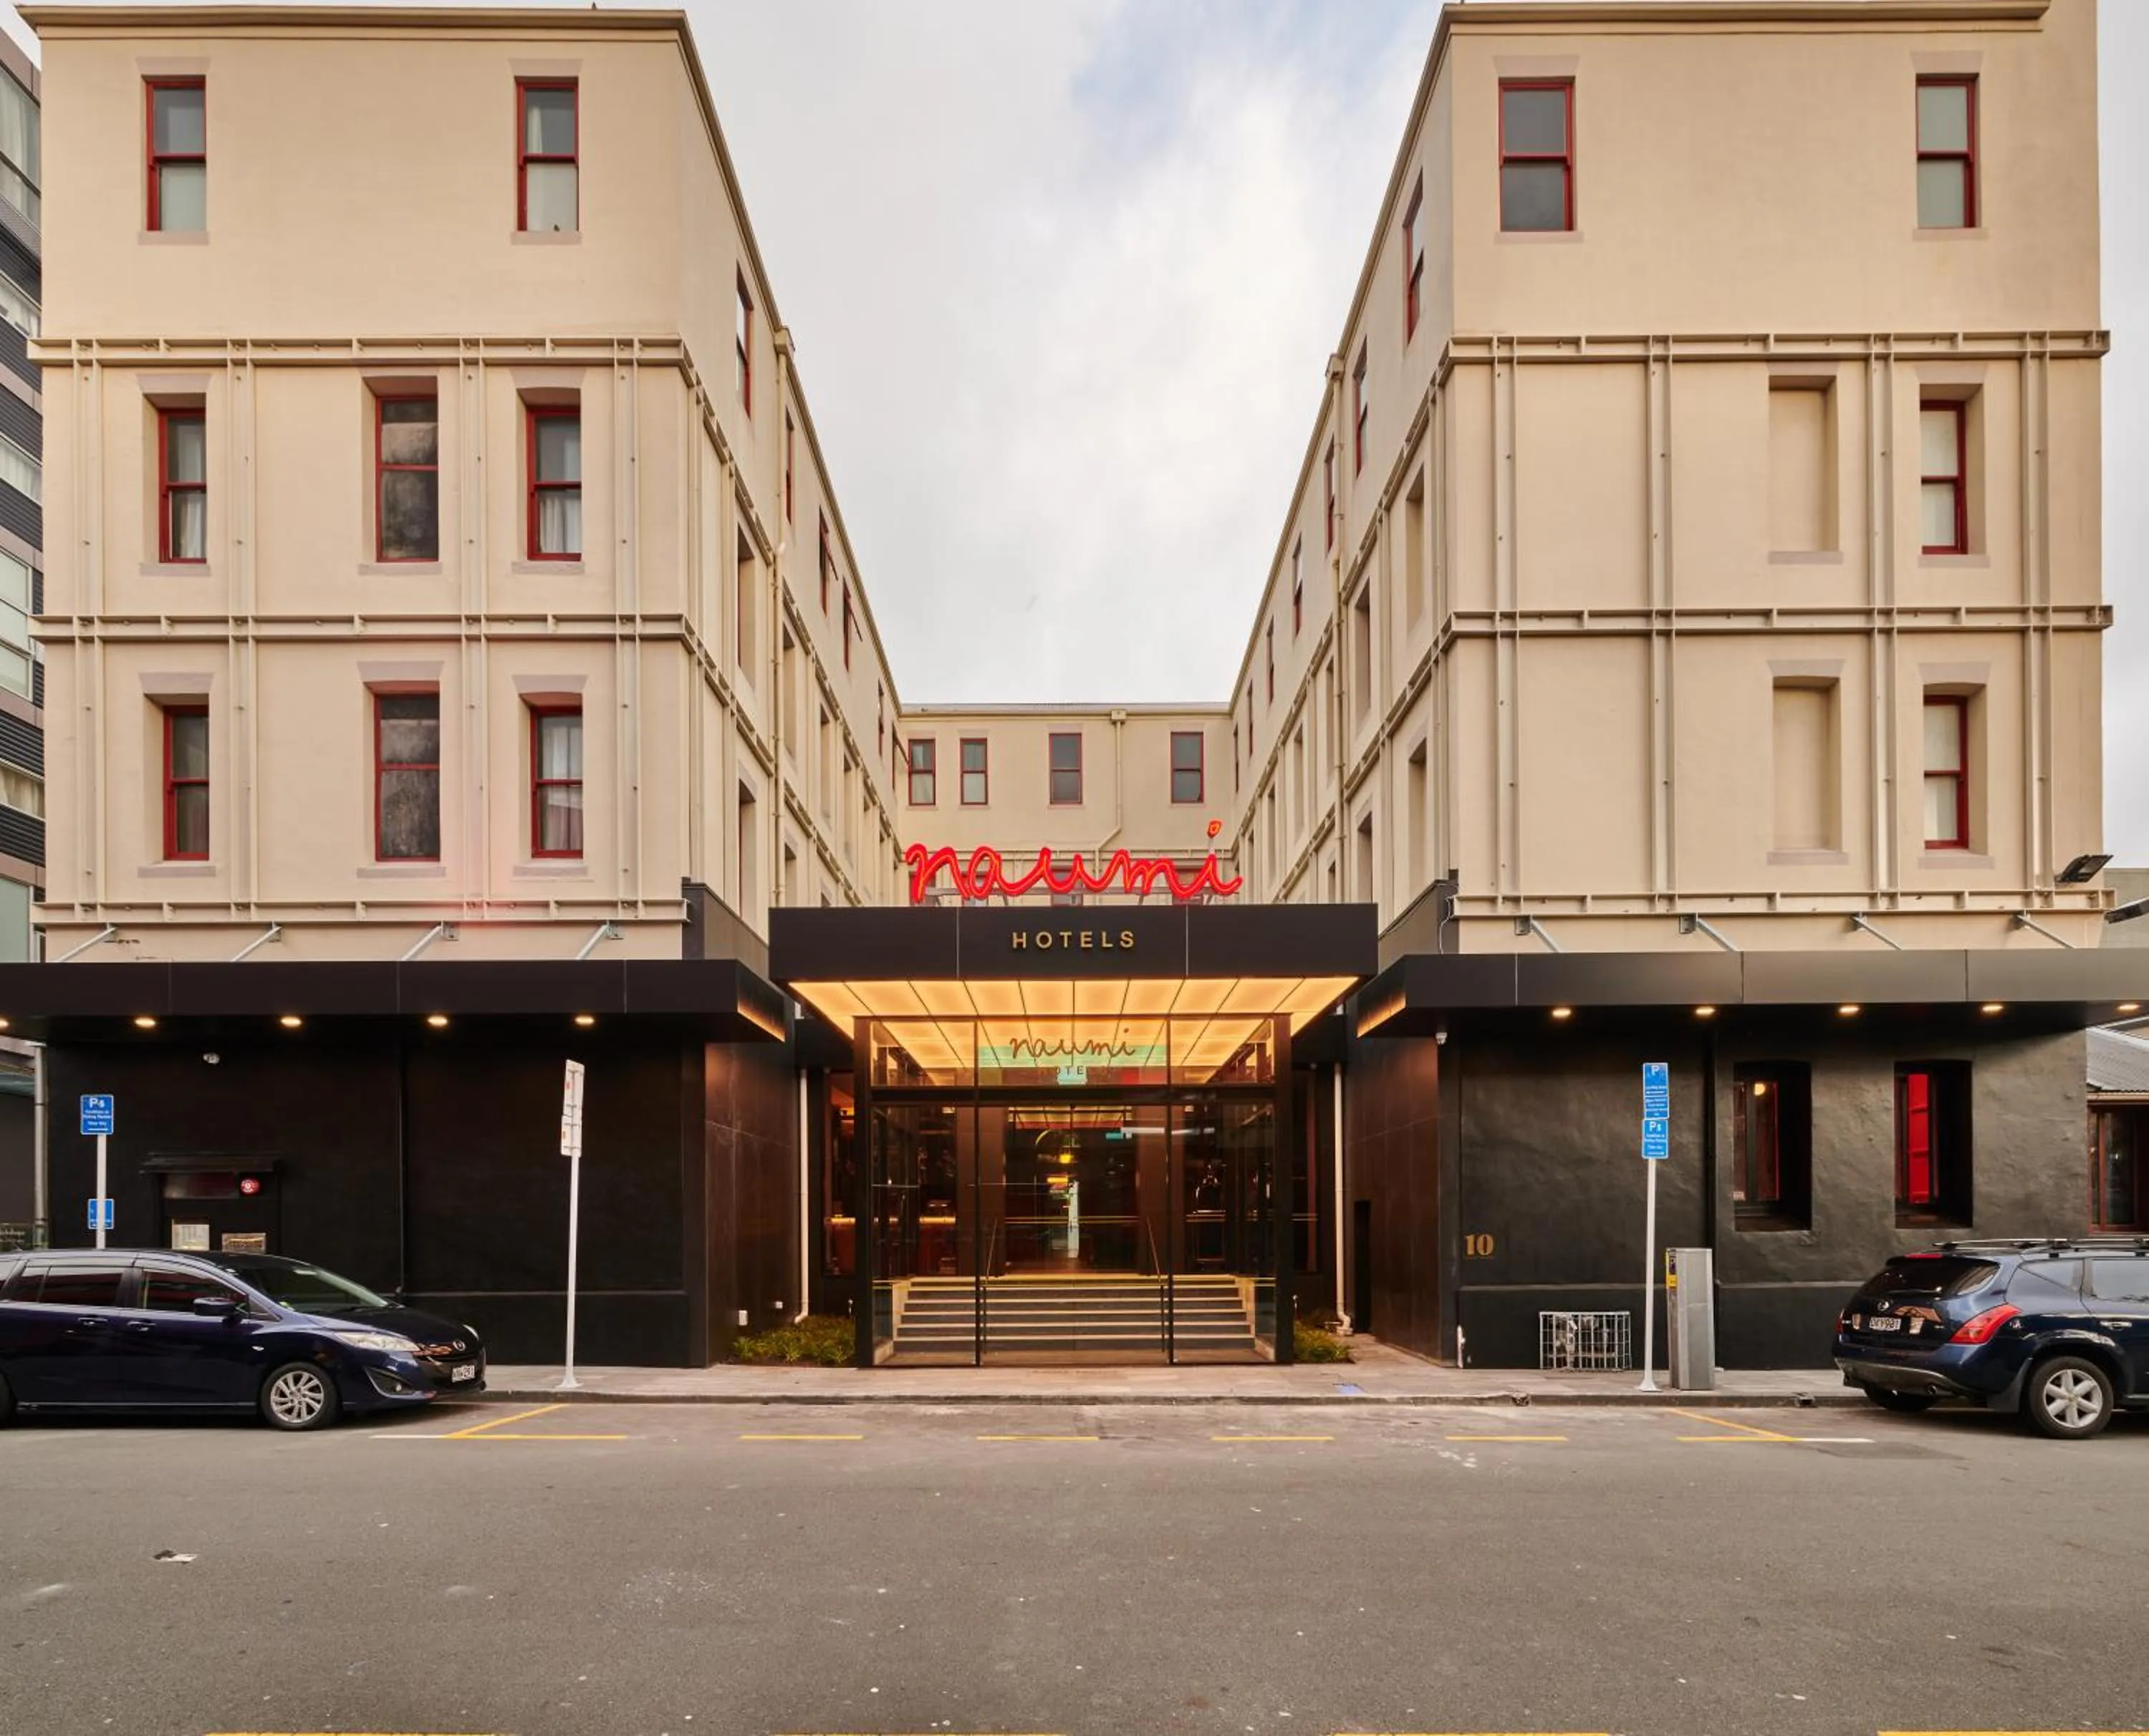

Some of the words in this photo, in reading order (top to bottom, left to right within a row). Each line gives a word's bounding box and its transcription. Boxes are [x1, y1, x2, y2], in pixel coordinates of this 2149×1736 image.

[905, 820, 1244, 904] naumi
[1012, 930, 1135, 949] HOTELS
[1009, 1027, 1136, 1060] naumi
[1464, 1233, 1494, 1255] 10
